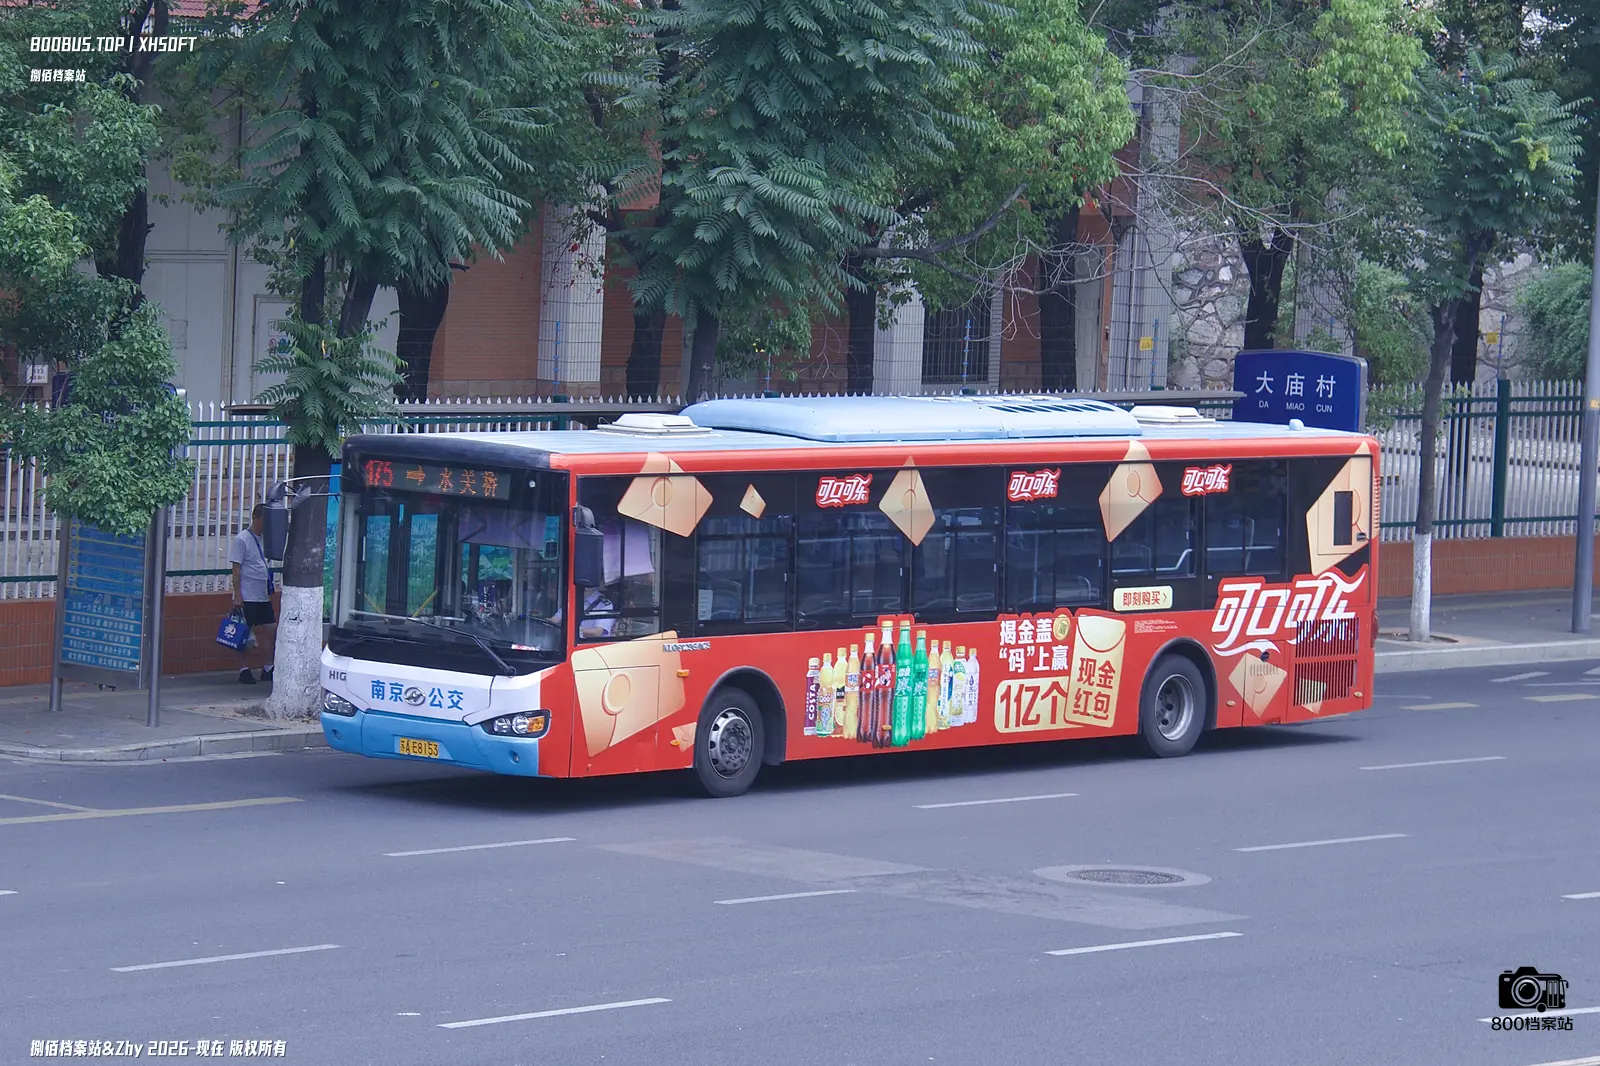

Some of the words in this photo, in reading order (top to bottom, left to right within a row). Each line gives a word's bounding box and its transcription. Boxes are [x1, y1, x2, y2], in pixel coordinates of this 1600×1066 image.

[1255, 370, 1336, 399] 大庙村
[1258, 400, 1269, 409] DA
[1285, 402, 1305, 411] MIAO
[1316, 404, 1332, 413] CUN
[365, 459, 393, 487] 175
[1009, 470, 1060, 499] 可口可乐
[1183, 465, 1231, 494] 可口可乐
[816, 475, 871, 505] 可口可乐
[1122, 590, 1161, 607] 即刻购买
[1211, 571, 1366, 656] 可口可乐
[999, 618, 1054, 646] 揭金盖
[329, 670, 347, 681] HIG
[1076, 657, 1116, 690] 现金
[371, 679, 403, 703] 南京
[428, 687, 463, 711] 公交
[808, 684, 816, 720] COSTA
[1072, 687, 1110, 721] 红包
